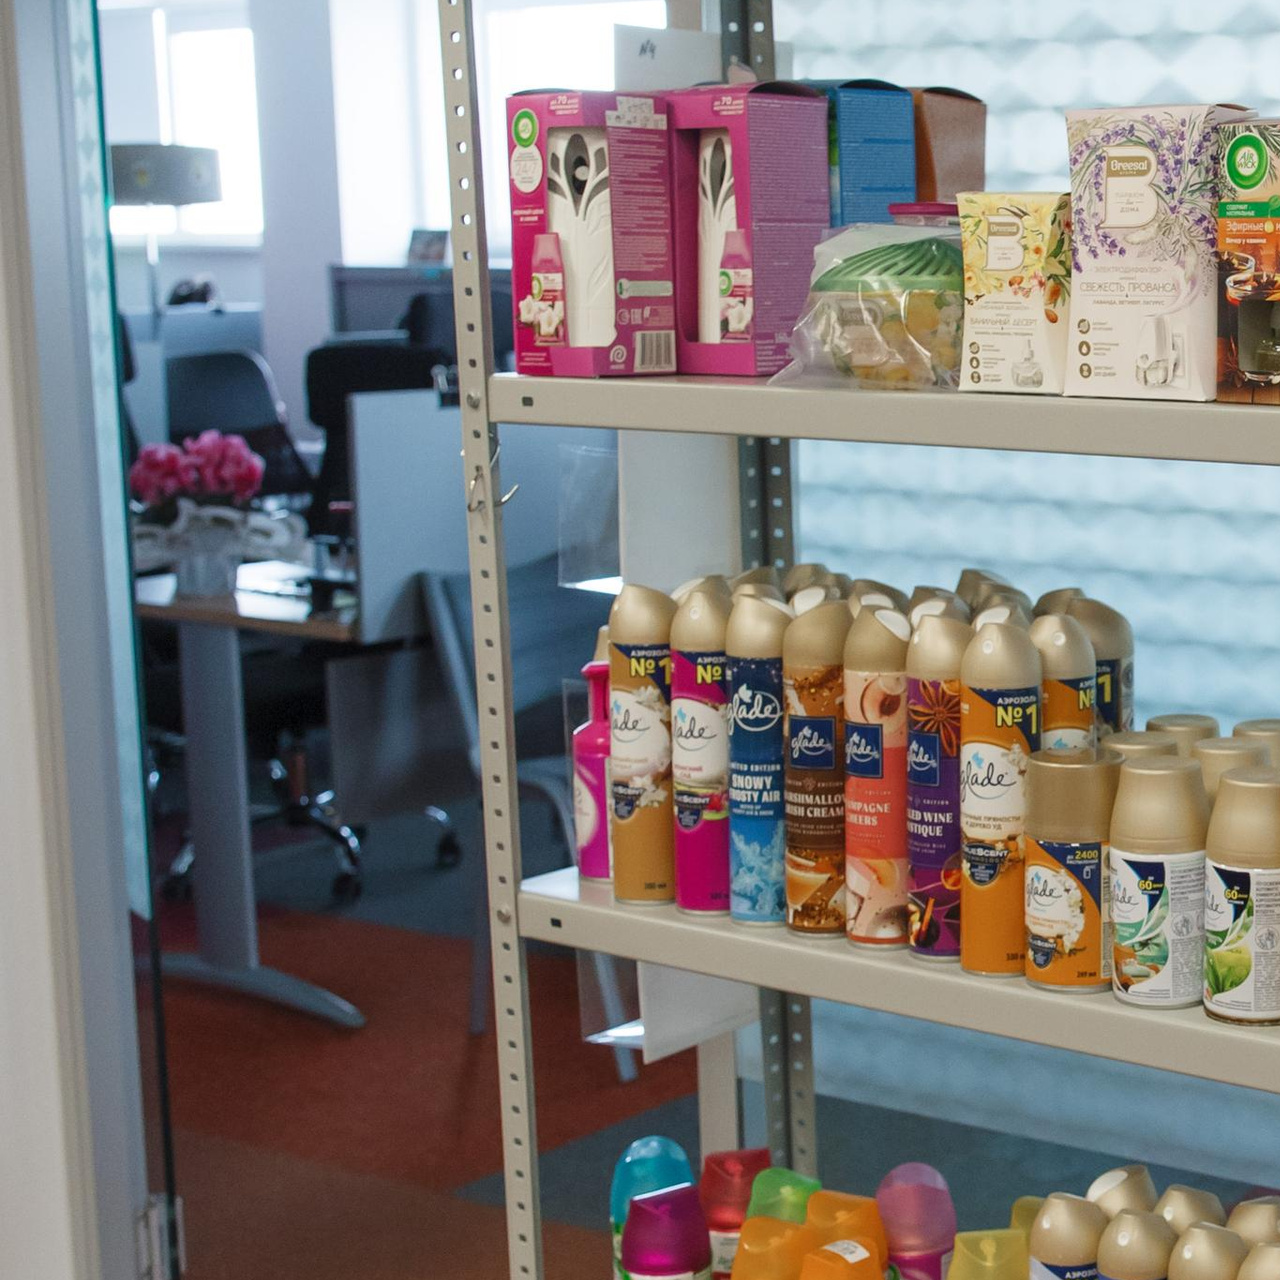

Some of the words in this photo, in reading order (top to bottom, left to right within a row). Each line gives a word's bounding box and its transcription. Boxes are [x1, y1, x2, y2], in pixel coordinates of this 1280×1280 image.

[1110, 159, 1148, 171] Breesal
[1119, 206, 1140, 214] ДОМА
[1226, 221, 1265, 233] Эфирные
[1079, 281, 1125, 293] СВЕЖЕСТЬ
[1128, 281, 1178, 293] ПРОВАНСА
[726, 692, 783, 736] glade
[1025, 704, 1038, 735] 1
[791, 729, 833, 759] glade
[732, 773, 773, 790] SNOWY
[762, 790, 781, 803] AIR
[807, 806, 845, 818] CREAM
[923, 811, 954, 824] WINE
[969, 821, 991, 830] ДЕРЕВО
[1075, 850, 1099, 860] 2400
[1138, 880, 1153, 891] 60
[1225, 890, 1239, 900] 60
